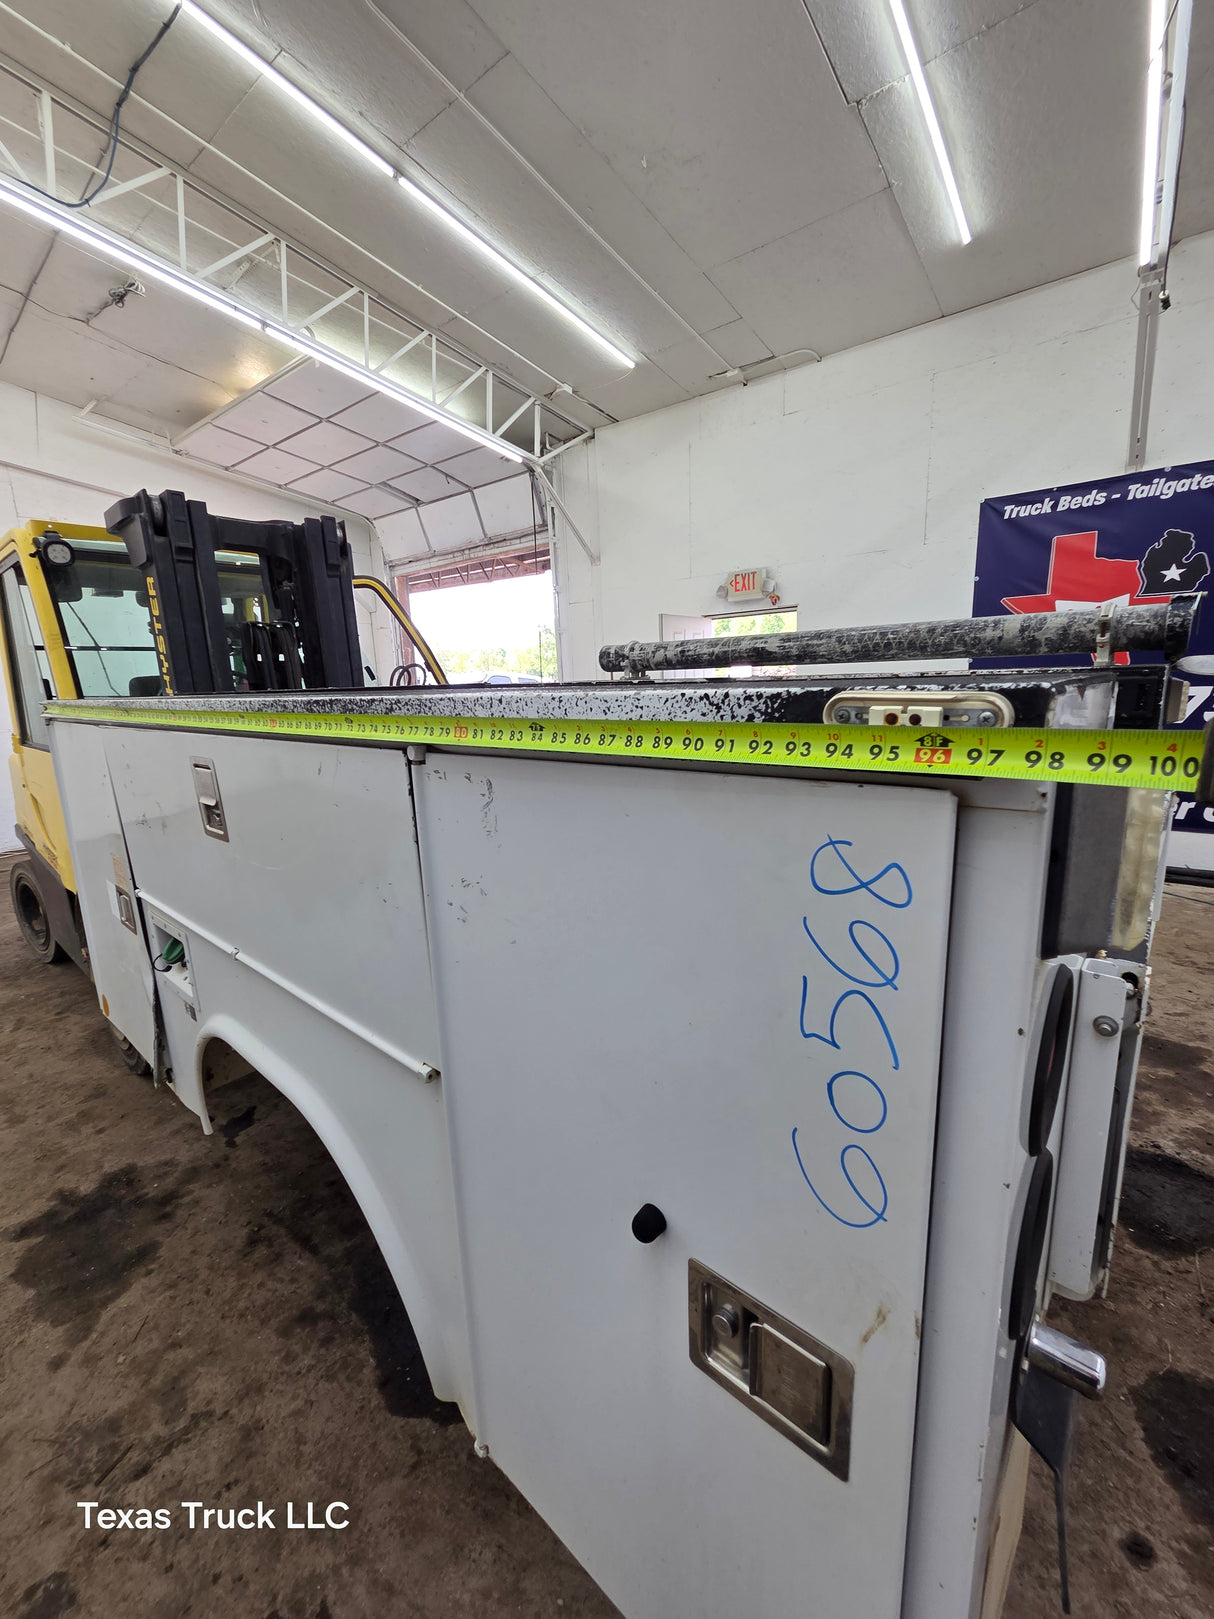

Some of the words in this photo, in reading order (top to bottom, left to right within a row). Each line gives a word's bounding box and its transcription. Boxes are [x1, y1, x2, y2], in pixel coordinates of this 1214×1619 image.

[1003, 498, 1054, 520] Truck
[1056, 490, 1108, 512] Beds
[1127, 473, 1214, 500] Tailgate
[734, 571, 757, 592] EXIT
[146, 576, 174, 697] HYSTER
[356, 724, 366, 733] 73
[370, 724, 378, 733] 74
[382, 724, 391, 734] 75
[394, 726, 405, 736] 76
[408, 726, 419, 736] 77
[423, 726, 434, 737] 78
[439, 727, 451, 738] 79
[472, 728, 484, 740] 81
[490, 729, 504, 740] 82
[509, 730, 523, 742] 83
[551, 732, 567, 744] 85
[574, 732, 591, 746] 86
[598, 734, 616, 746] 87
[624, 734, 644, 748] 88
[652, 736, 673, 750] 89
[682, 736, 704, 752] 90
[714, 738, 736, 753] 91
[748, 739, 774, 755] 92
[785, 740, 812, 758] 93
[825, 742, 854, 760] 94
[869, 744, 900, 762] 95
[918, 749, 946, 763] 96
[966, 748, 1006, 767] 97
[1024, 750, 1065, 770] 98
[1086, 752, 1132, 774] 99
[1150, 755, 1200, 778] 100
[685, 728, 691, 736] 6
[752, 730, 758, 738] 8
[790, 732, 797, 740] 9
[828, 733, 840, 741] 10
[872, 734, 884, 742] 11
[978, 738, 984, 746] 1
[1035, 740, 1044, 748] 2
[1098, 741, 1107, 750] 3
[1166, 744, 1178, 753] 4
[792, 833, 913, 1229] 60568
